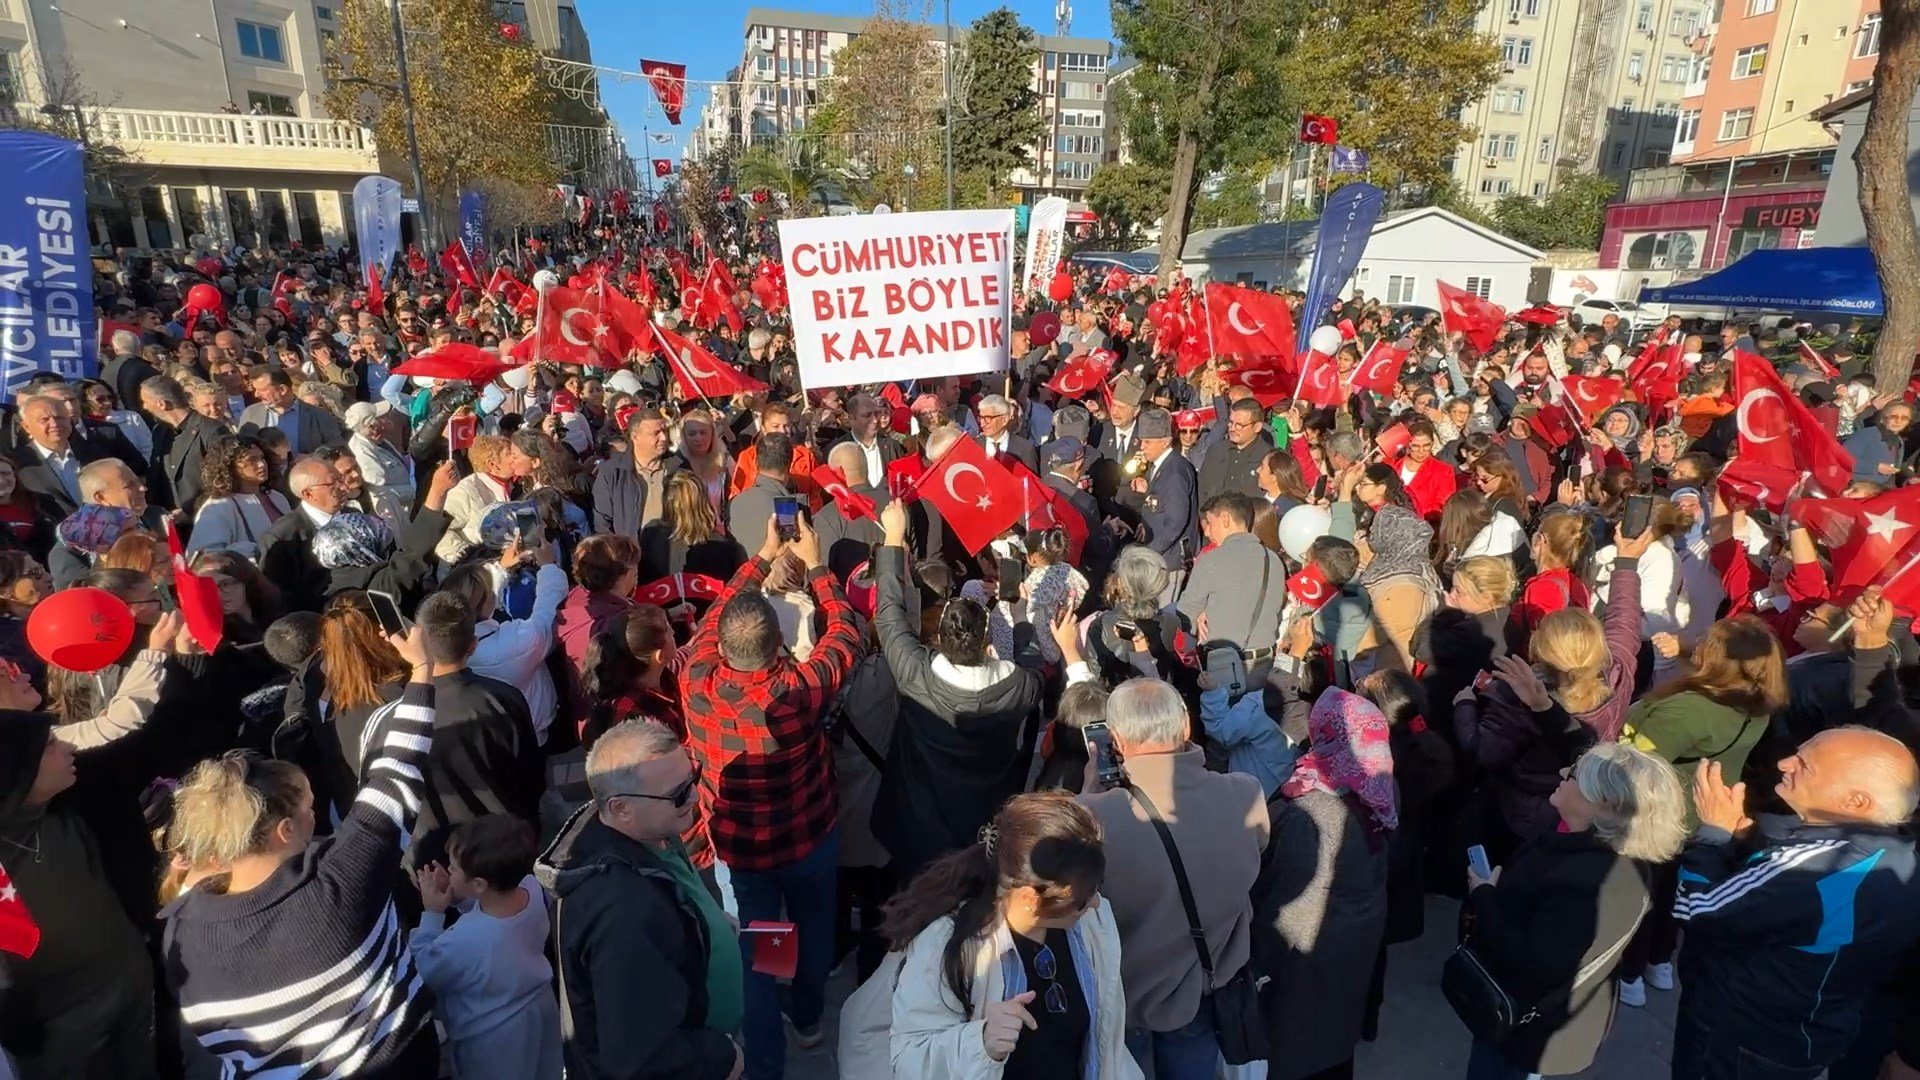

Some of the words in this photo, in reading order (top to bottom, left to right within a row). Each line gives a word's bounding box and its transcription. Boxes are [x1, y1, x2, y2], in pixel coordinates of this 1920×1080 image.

[25, 196, 84, 380] ELEDİYESİ
[884, 275, 1000, 315] BÖYLE
[821, 317, 1004, 363] KAZANDIK
